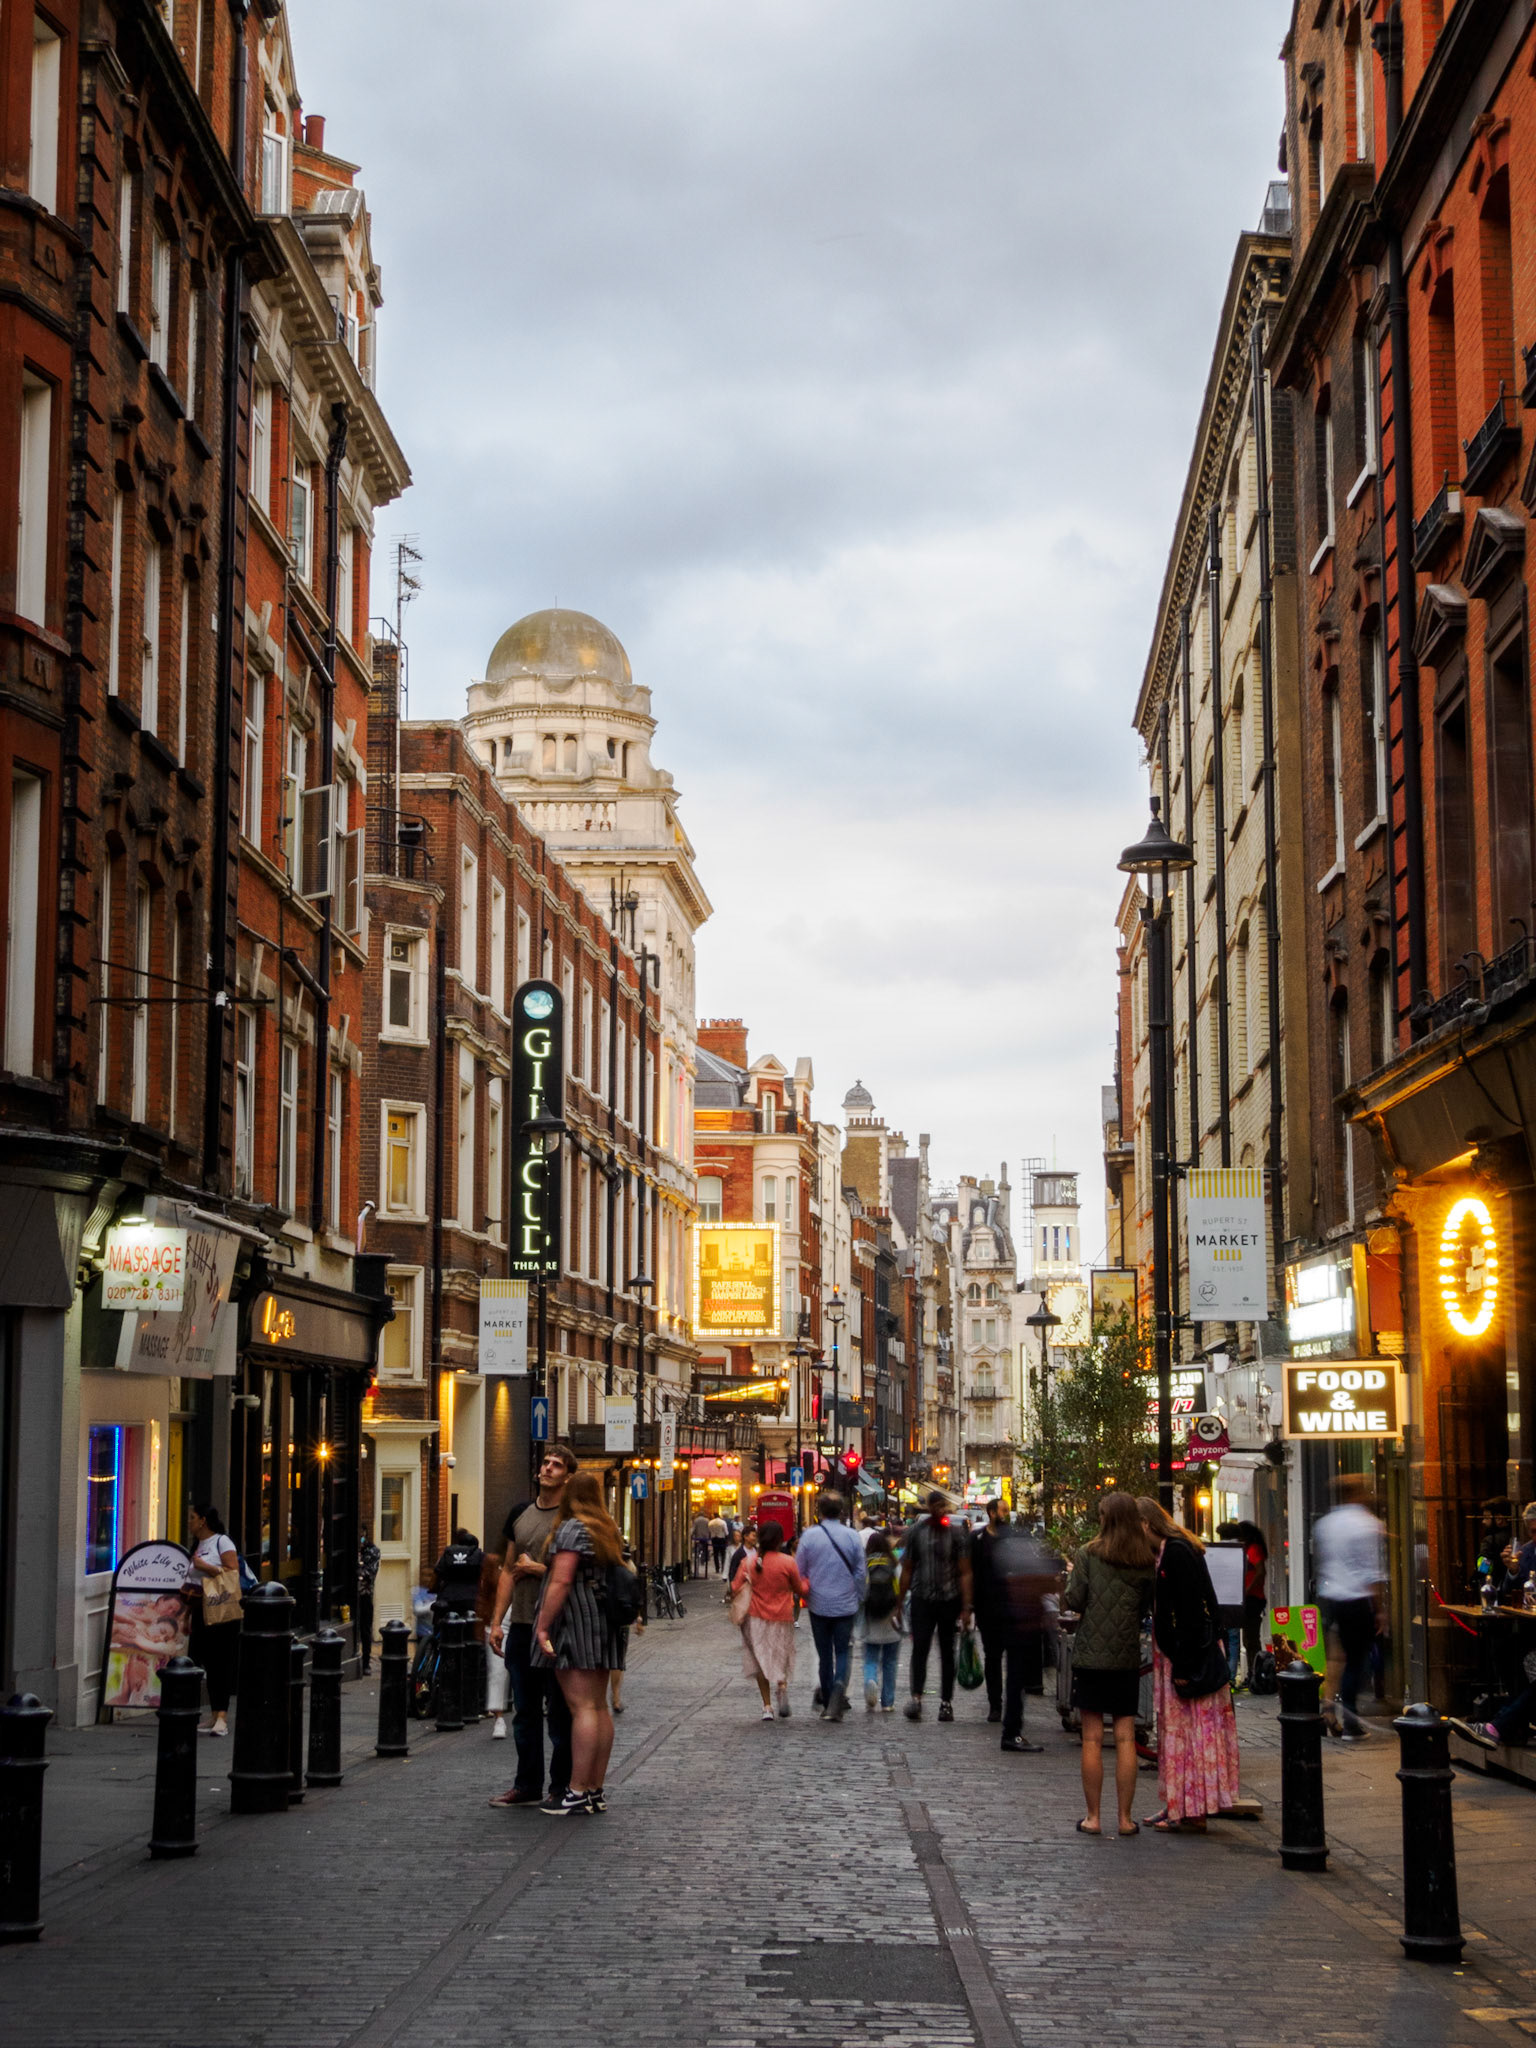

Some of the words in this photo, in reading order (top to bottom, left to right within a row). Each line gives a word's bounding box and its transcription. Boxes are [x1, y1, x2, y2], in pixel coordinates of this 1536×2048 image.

[1202, 1216, 1234, 1225] RUPERT
[1238, 1217, 1248, 1225] ST
[1196, 1234, 1259, 1246] MARKET
[108, 1244, 182, 1274] MASSAGE
[513, 1261, 558, 1271] THEARE
[107, 1286, 126, 1300] 020
[130, 1287, 154, 1300] 7287
[484, 1320, 523, 1329] MARKET
[1180, 1371, 1203, 1384] AND
[1297, 1370, 1386, 1391] FOOD
[1146, 1398, 1195, 1414] 2/7
[1330, 1391, 1356, 1411] &
[1298, 1411, 1388, 1432] WINE
[1192, 1446, 1229, 1456] payzone
[123, 1559, 149, 1577] White
[152, 1553, 172, 1568] Lily
